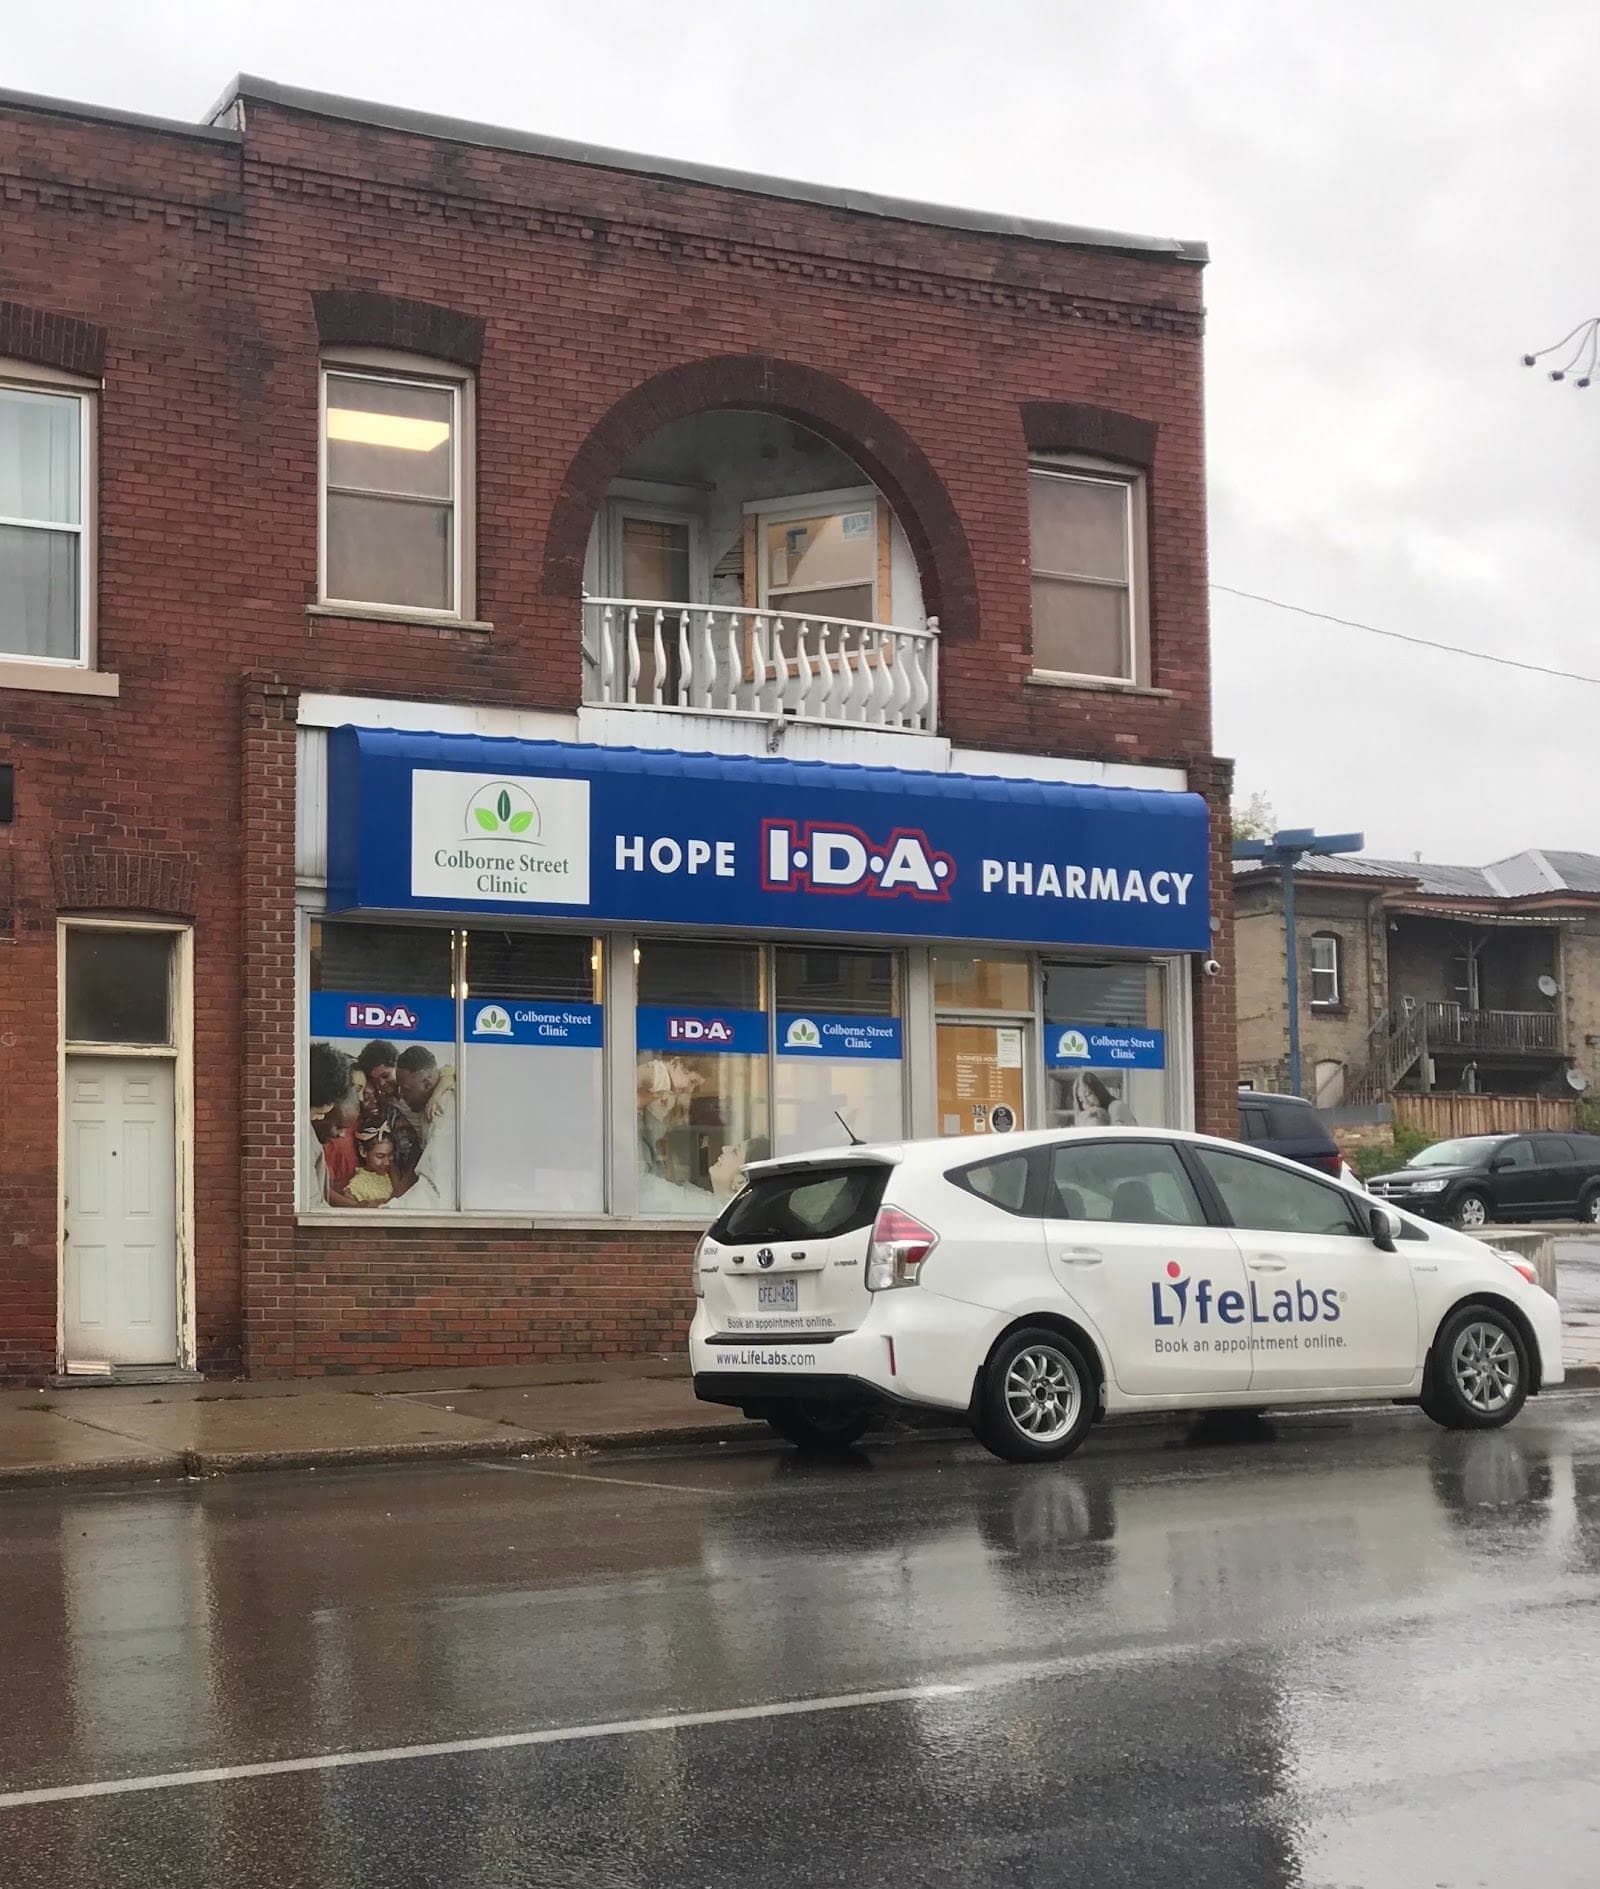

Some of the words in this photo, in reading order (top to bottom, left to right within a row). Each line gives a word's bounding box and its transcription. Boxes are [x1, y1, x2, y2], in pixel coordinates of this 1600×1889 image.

[434, 850, 515, 871] Colborne
[519, 854, 569, 874] Street
[614, 835, 736, 877] HOPE
[982, 859, 1194, 905] PHARMACY
[477, 874, 528, 894] Clinic
[514, 1010, 561, 1025] Colborne
[562, 1013, 592, 1025] Street
[538, 1025, 569, 1037] Clinic
[822, 1023, 866, 1037] Colborne
[867, 1025, 893, 1038] Street
[844, 1037, 872, 1049] Clinic
[1090, 1035, 1129, 1048] Colborne
[1130, 1037, 1155, 1049] Street
[1110, 1048, 1136, 1060] Clinic
[971, 1103, 988, 1116] 324
[727, 1318, 744, 1329] Book
[745, 1321, 754, 1329] an
[755, 1318, 804, 1331] appointment
[805, 1316, 836, 1328] online.
[1154, 1338, 1189, 1353] Book
[1193, 1341, 1210, 1352] an
[1214, 1336, 1299, 1353] appointment
[1304, 1334, 1347, 1349] online.
[716, 1350, 816, 1367] www.LifeLabs.com
